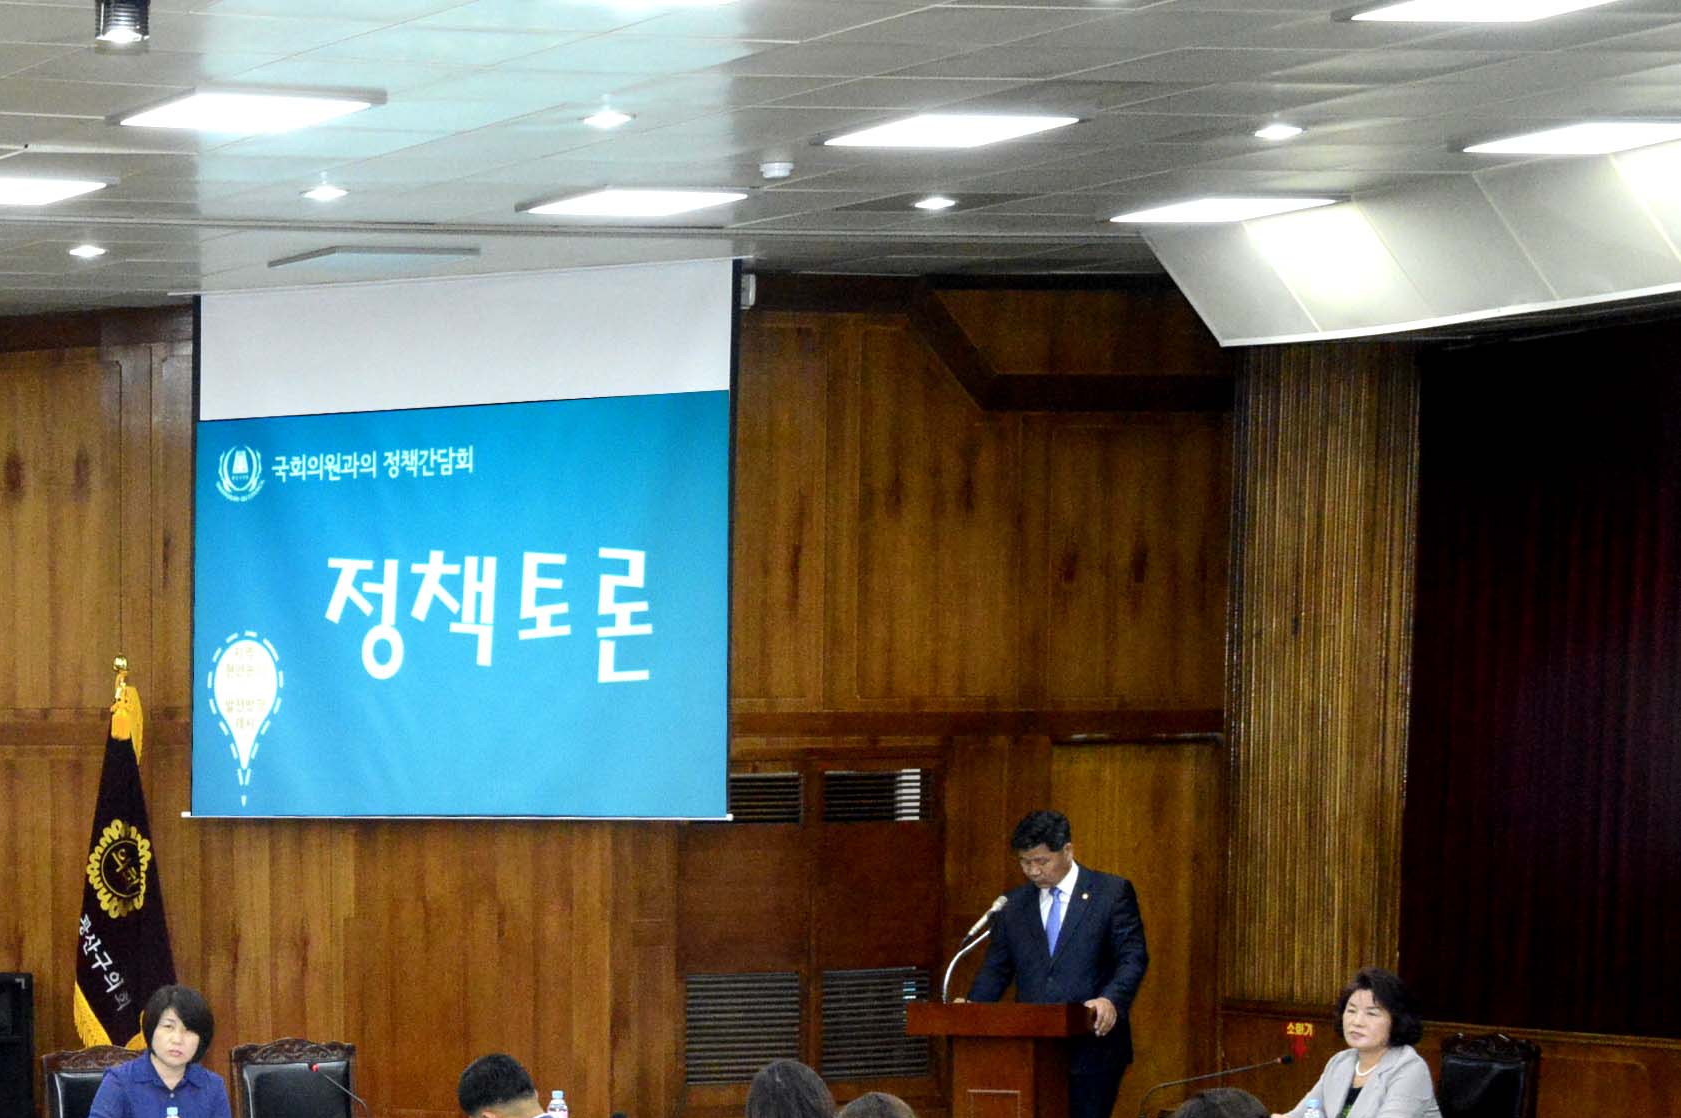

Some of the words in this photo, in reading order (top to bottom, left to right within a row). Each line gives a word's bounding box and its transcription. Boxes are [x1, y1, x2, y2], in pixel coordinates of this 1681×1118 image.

[272, 451, 377, 483] 국회의원과의
[383, 445, 474, 479] 정책간담회
[324, 547, 654, 684] 정책토론
